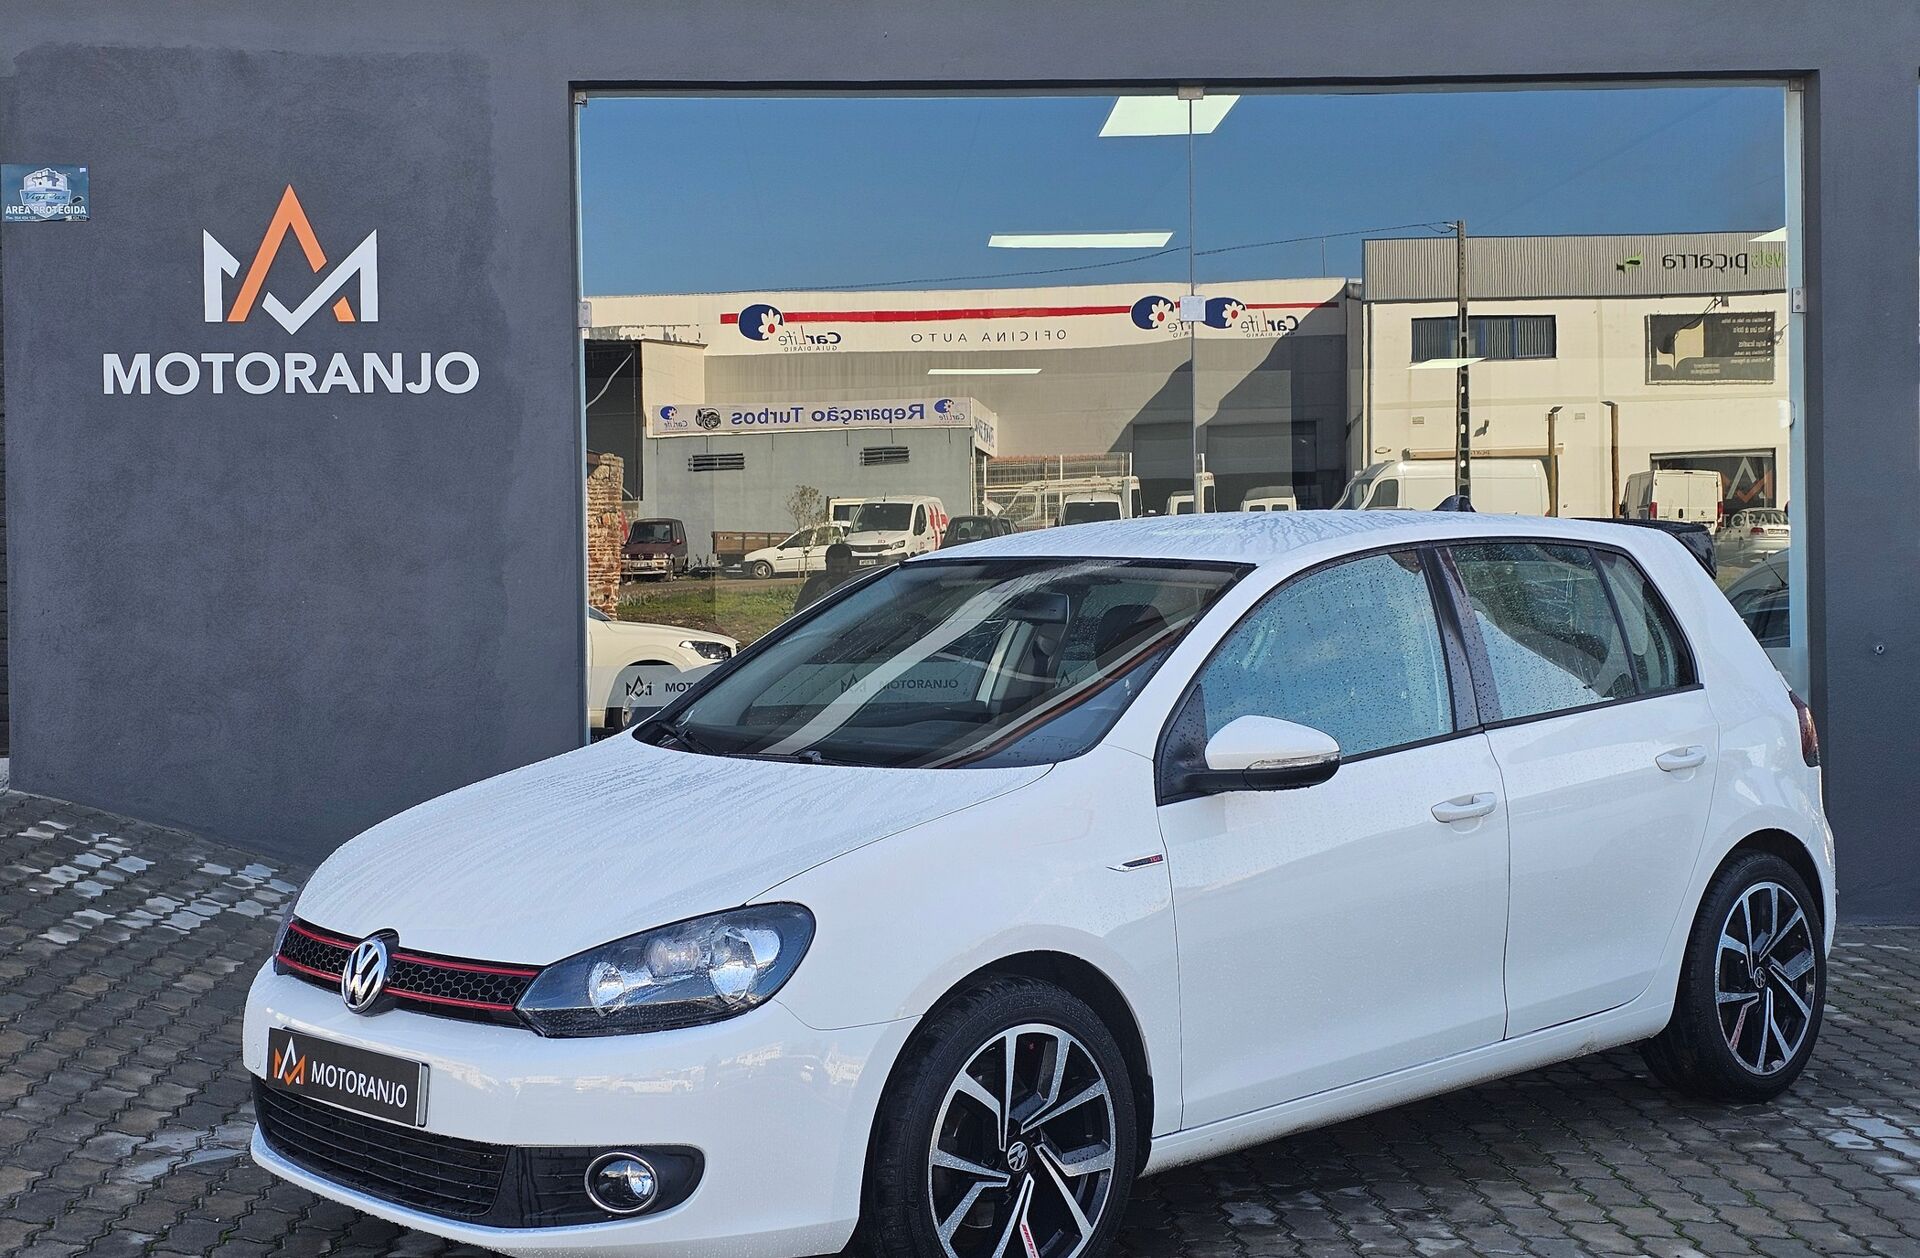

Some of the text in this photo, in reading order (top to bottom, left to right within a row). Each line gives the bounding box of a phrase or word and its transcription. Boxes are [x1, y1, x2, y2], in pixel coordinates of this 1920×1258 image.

[34, 205, 87, 215] PROTEGIDA
[102, 351, 480, 395] MOTORANJO
[311, 1061, 408, 1108] MOTORANJO
